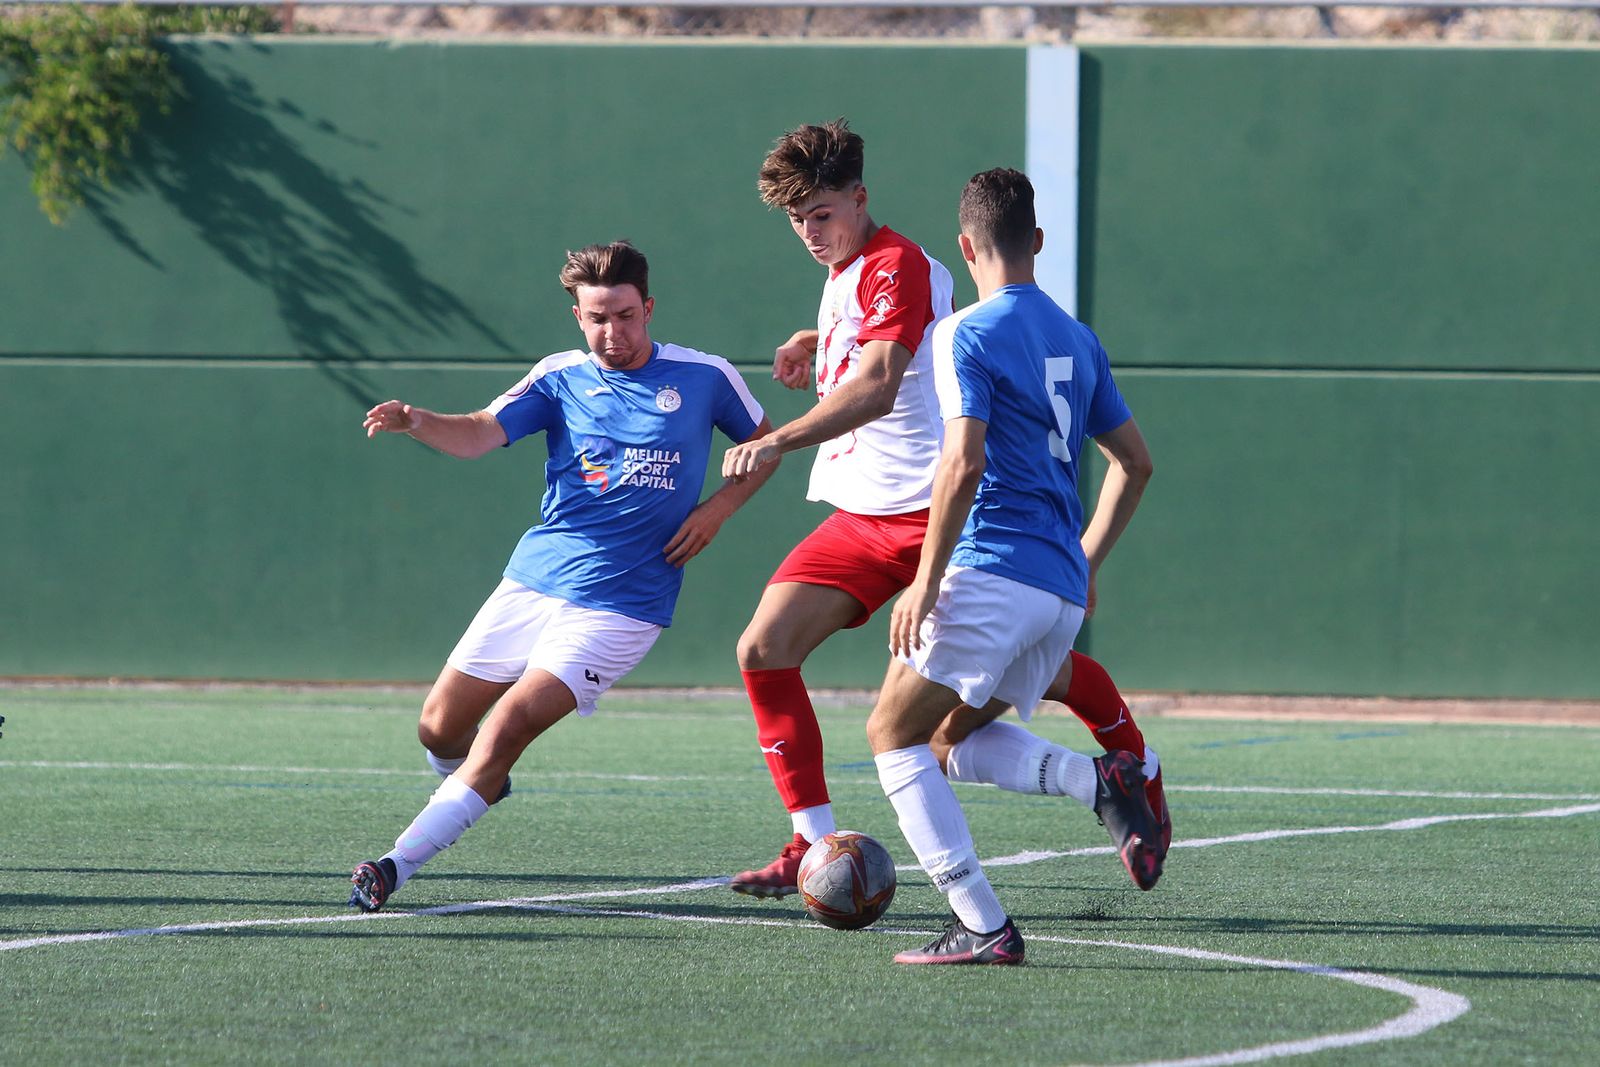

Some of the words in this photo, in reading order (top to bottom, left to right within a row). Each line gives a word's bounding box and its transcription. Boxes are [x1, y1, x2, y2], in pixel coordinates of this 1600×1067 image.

[1044, 356, 1073, 463] 5
[623, 447, 681, 464] MELILLA
[622, 460, 670, 476] SPORT
[619, 474, 676, 490] CAPITAL
[1039, 753, 1052, 794] adidas
[936, 868, 970, 887] didas
